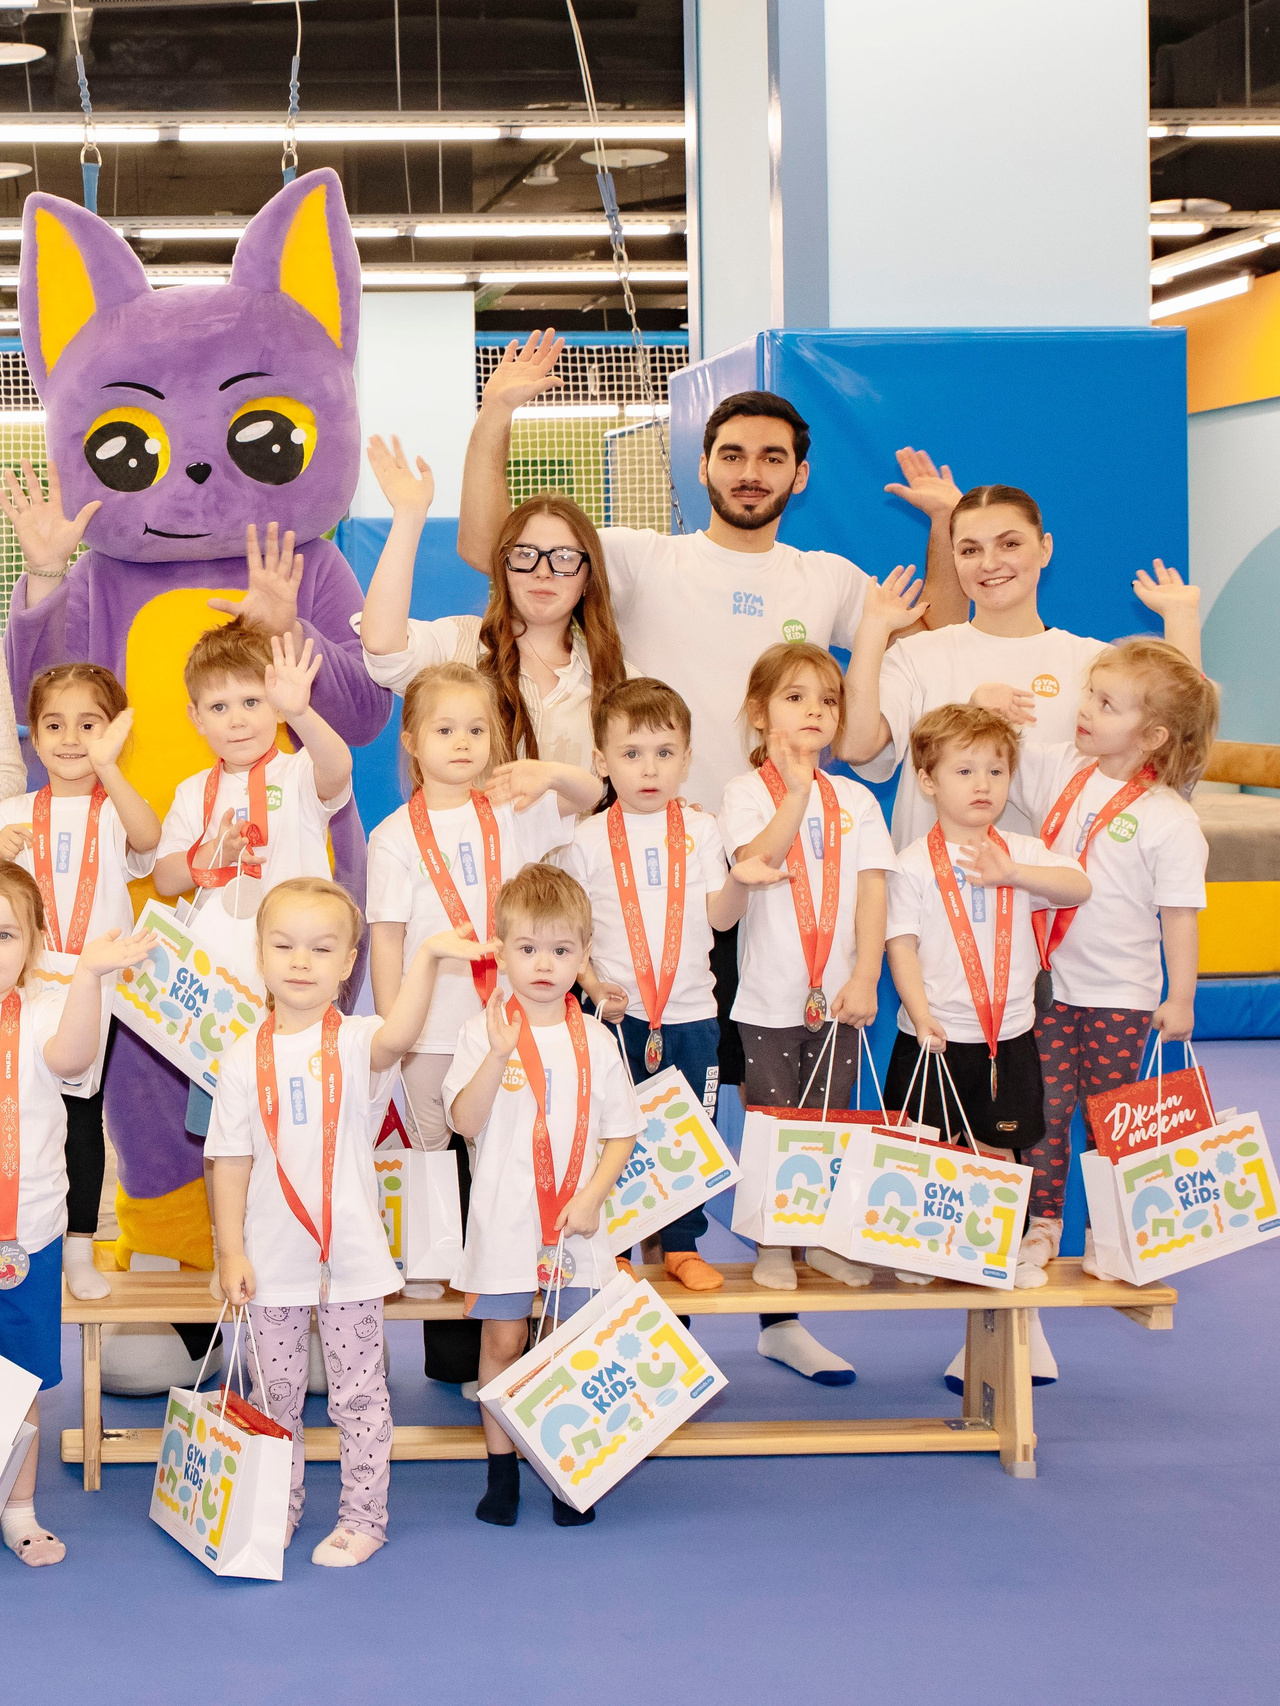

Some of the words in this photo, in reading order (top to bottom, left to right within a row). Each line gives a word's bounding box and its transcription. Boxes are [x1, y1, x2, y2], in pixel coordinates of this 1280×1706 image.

[732, 591, 764, 606] GYM
[732, 603, 764, 618] KiDs
[783, 624, 804, 634] GYM
[1034, 678, 1058, 689] GYM
[1108, 824, 1132, 840] KiDs
[1112, 816, 1136, 833] GYM
[176, 967, 210, 1004] GYM
[169, 982, 203, 1018] KiDs
[501, 1076, 524, 1086] KiDs
[707, 1068, 718, 1076] Ge
[706, 1082, 716, 1090] Ni
[615, 1157, 656, 1189] KiDs
[1174, 1168, 1216, 1194] GYM
[924, 1182, 964, 1207] GYM
[1179, 1186, 1220, 1211] KiDs
[923, 1200, 964, 1224] KiDs
[581, 1360, 626, 1400] GYM
[592, 1376, 637, 1415] KiDs
[186, 1443, 208, 1473] GYM
[183, 1462, 204, 1492] KiDs
